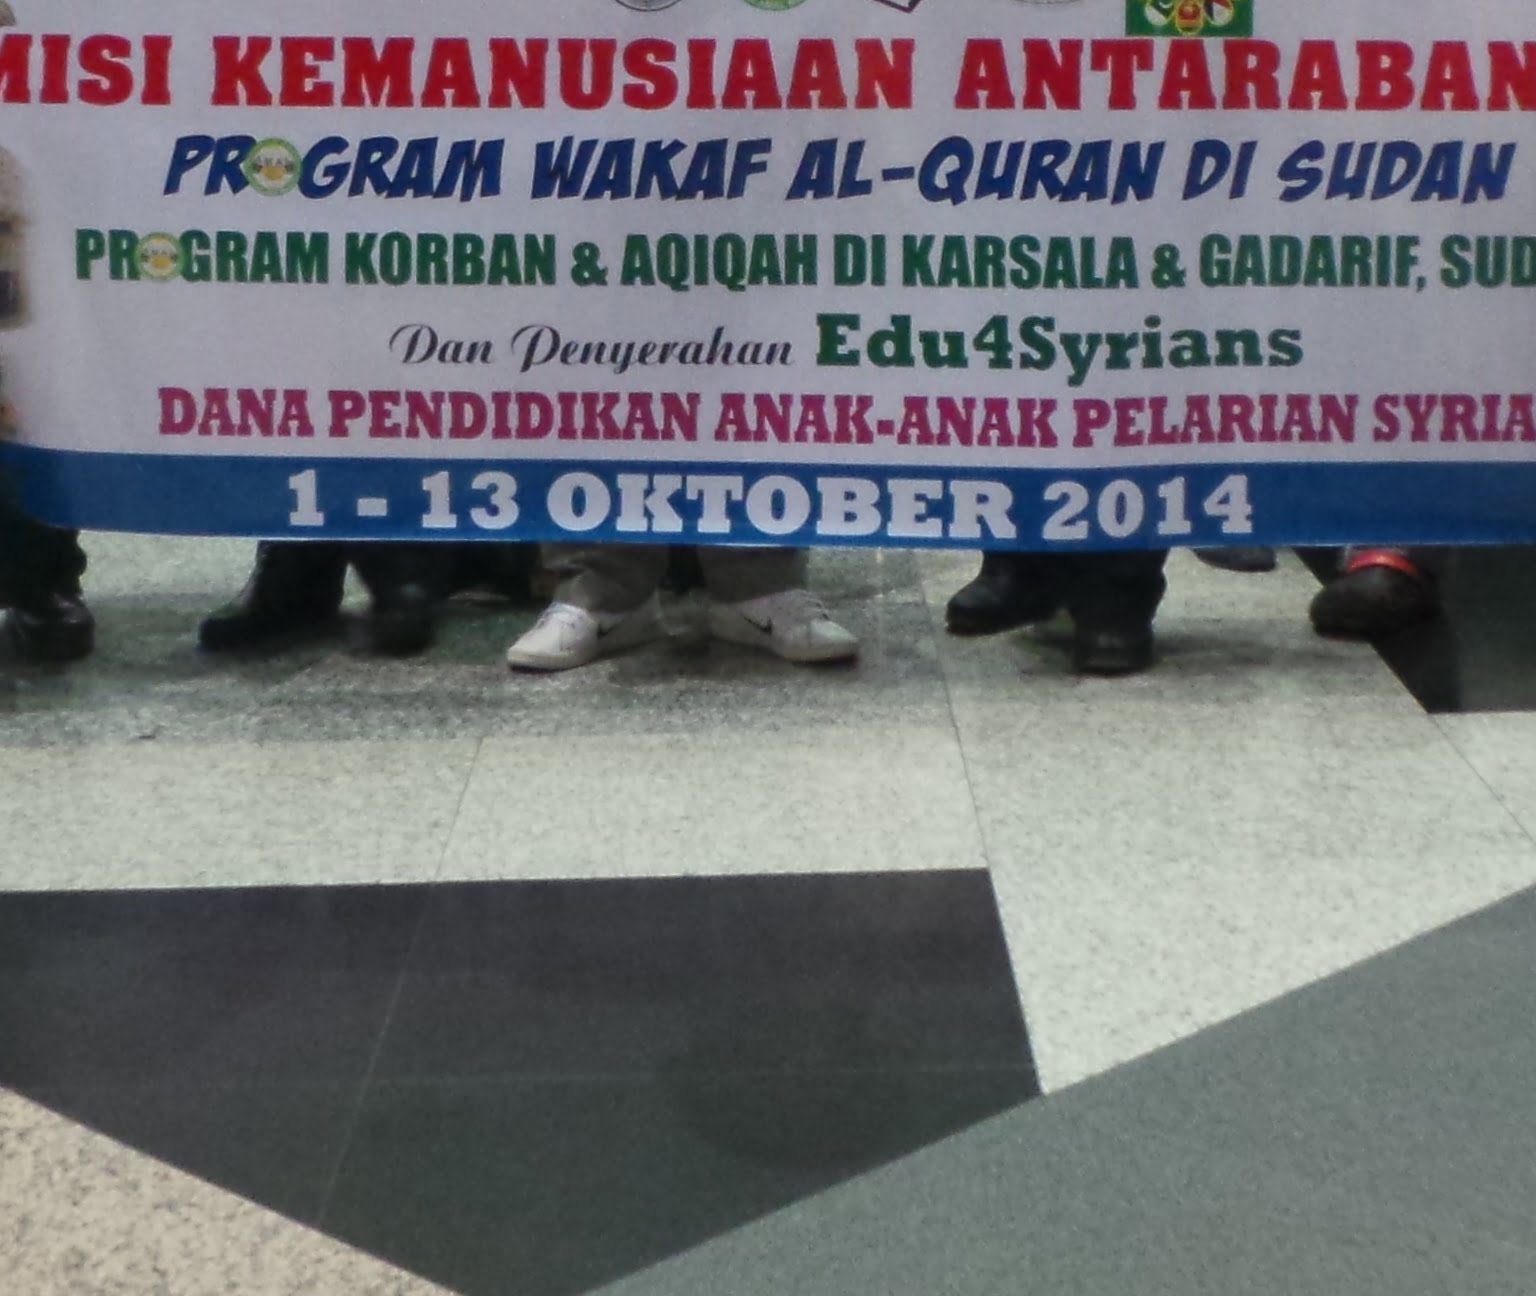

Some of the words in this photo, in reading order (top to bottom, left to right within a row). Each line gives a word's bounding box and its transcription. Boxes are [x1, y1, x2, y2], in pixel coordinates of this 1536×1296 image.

[211, 36, 915, 110] KEMANUSIAAN
[163, 134, 505, 202] PROGRAM
[530, 135, 772, 200] WAKAF
[786, 136, 1166, 204] AL-QURAN
[1182, 138, 1258, 201] DI
[1277, 139, 1517, 205] SUDAN
[76, 229, 331, 284] PROGRAM
[345, 231, 558, 285] KORBAN
[571, 242, 608, 286] &
[620, 233, 819, 291] AQIQAH
[834, 233, 888, 286] DI
[902, 234, 1140, 289] KARSALA
[1151, 245, 1187, 290] &
[1199, 234, 1426, 293] GADARIF,
[388, 323, 495, 365] Dan
[509, 325, 795, 375] Penyerahan
[816, 313, 1304, 387] Edu4Syrians
[158, 387, 316, 437] DANA
[328, 389, 700, 441] PENDIDIKAN
[714, 393, 1059, 447] ANAK-ANAK
[1072, 393, 1360, 446] PELARIAN
[288, 468, 325, 527] 1
[357, 497, 388, 516] -
[421, 470, 520, 530] 13
[546, 472, 1019, 538] OKTOBER
[1041, 474, 1254, 540] 2014
